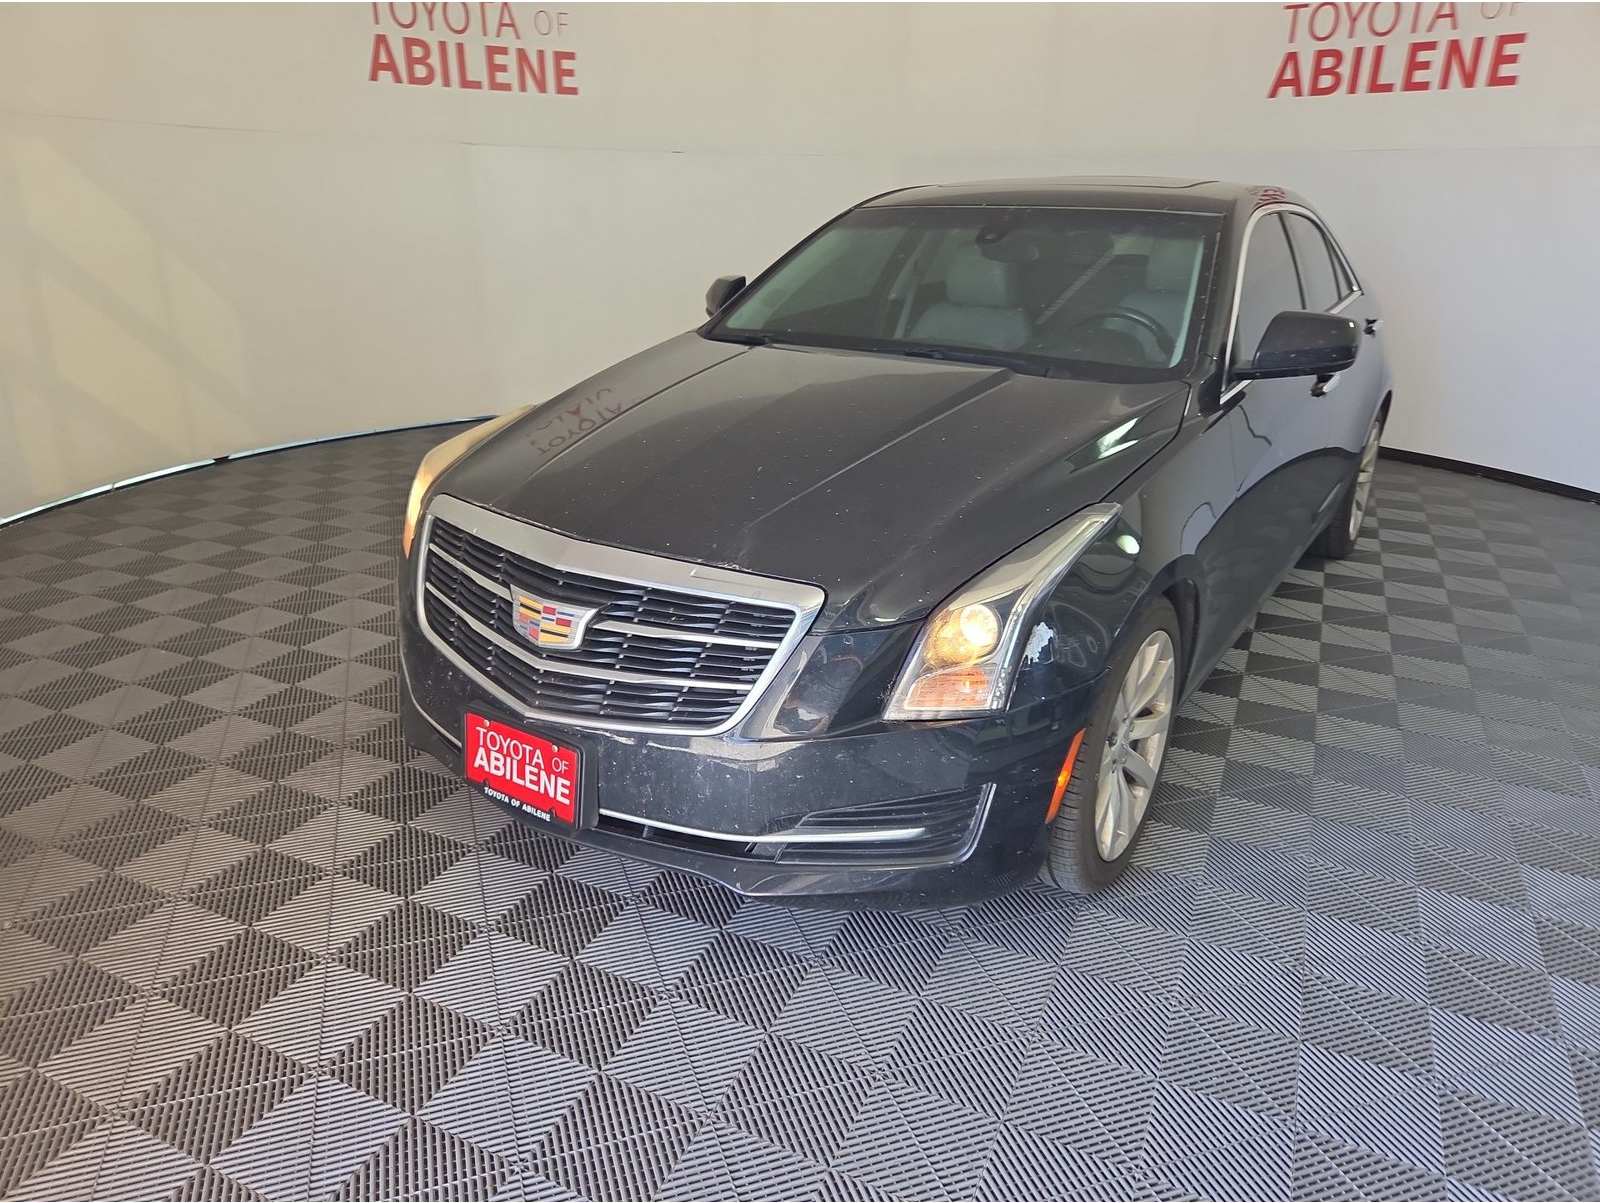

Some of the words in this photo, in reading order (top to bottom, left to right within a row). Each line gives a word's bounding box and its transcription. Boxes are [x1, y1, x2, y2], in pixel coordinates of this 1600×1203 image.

[534, 10, 568, 36] OF
[368, 33, 579, 95] ABILENE
[1267, 33, 1528, 98] ABILENE
[473, 746, 571, 806] ABILENE
[475, 726, 545, 769] TOYOTA
[551, 757, 569, 773] OF
[484, 786, 510, 803] TOYOTA
[511, 798, 521, 808] OF
[522, 803, 551, 822] ABILENE
